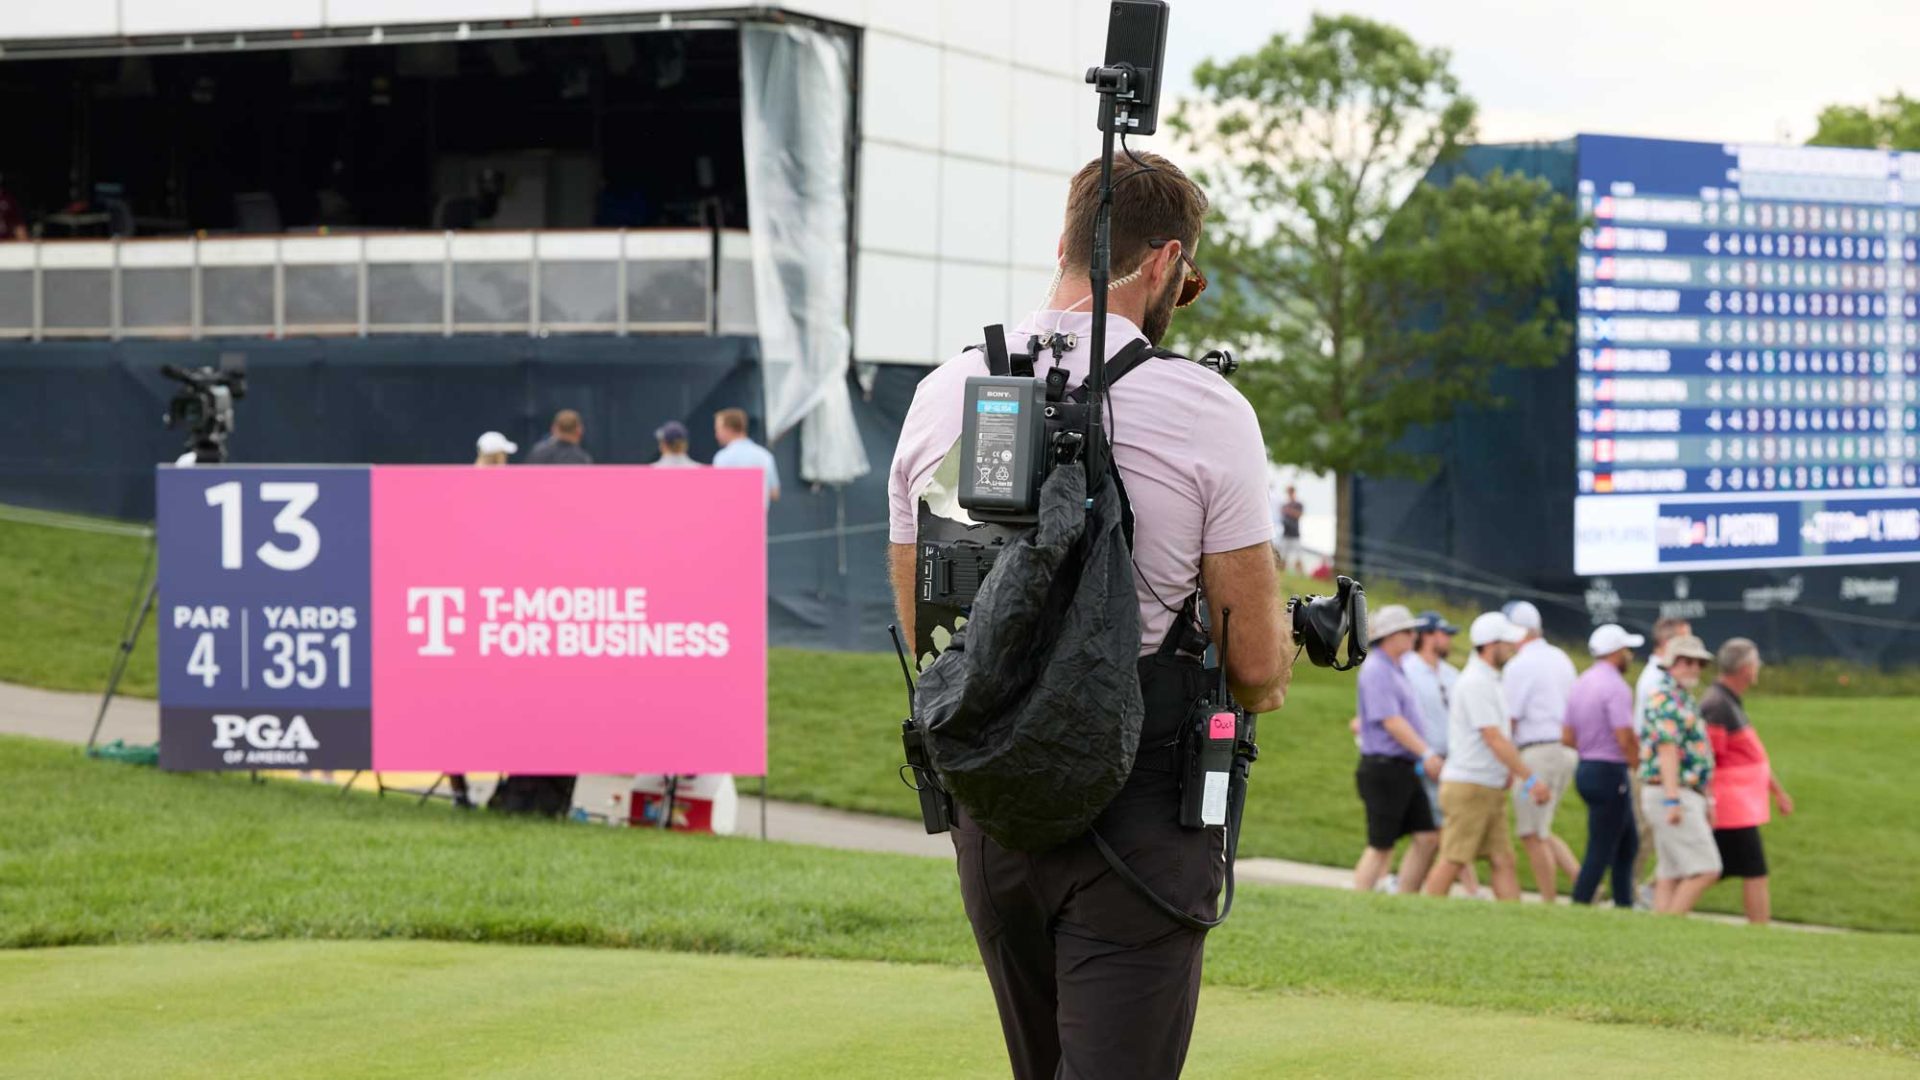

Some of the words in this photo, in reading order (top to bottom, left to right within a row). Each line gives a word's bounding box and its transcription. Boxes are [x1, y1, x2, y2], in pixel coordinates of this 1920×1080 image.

[204, 481, 320, 571] 13
[174, 606, 230, 629] PAR
[263, 606, 357, 629] YARDS
[479, 587, 646, 622] T-MOBILE
[479, 622, 550, 656] FOR
[557, 622, 729, 657] BUSINESS
[187, 633, 220, 687] 4
[263, 632, 351, 689] 351
[212, 714, 319, 749] PGA
[223, 750, 243, 764] OF
[246, 750, 308, 765] AMERICA
